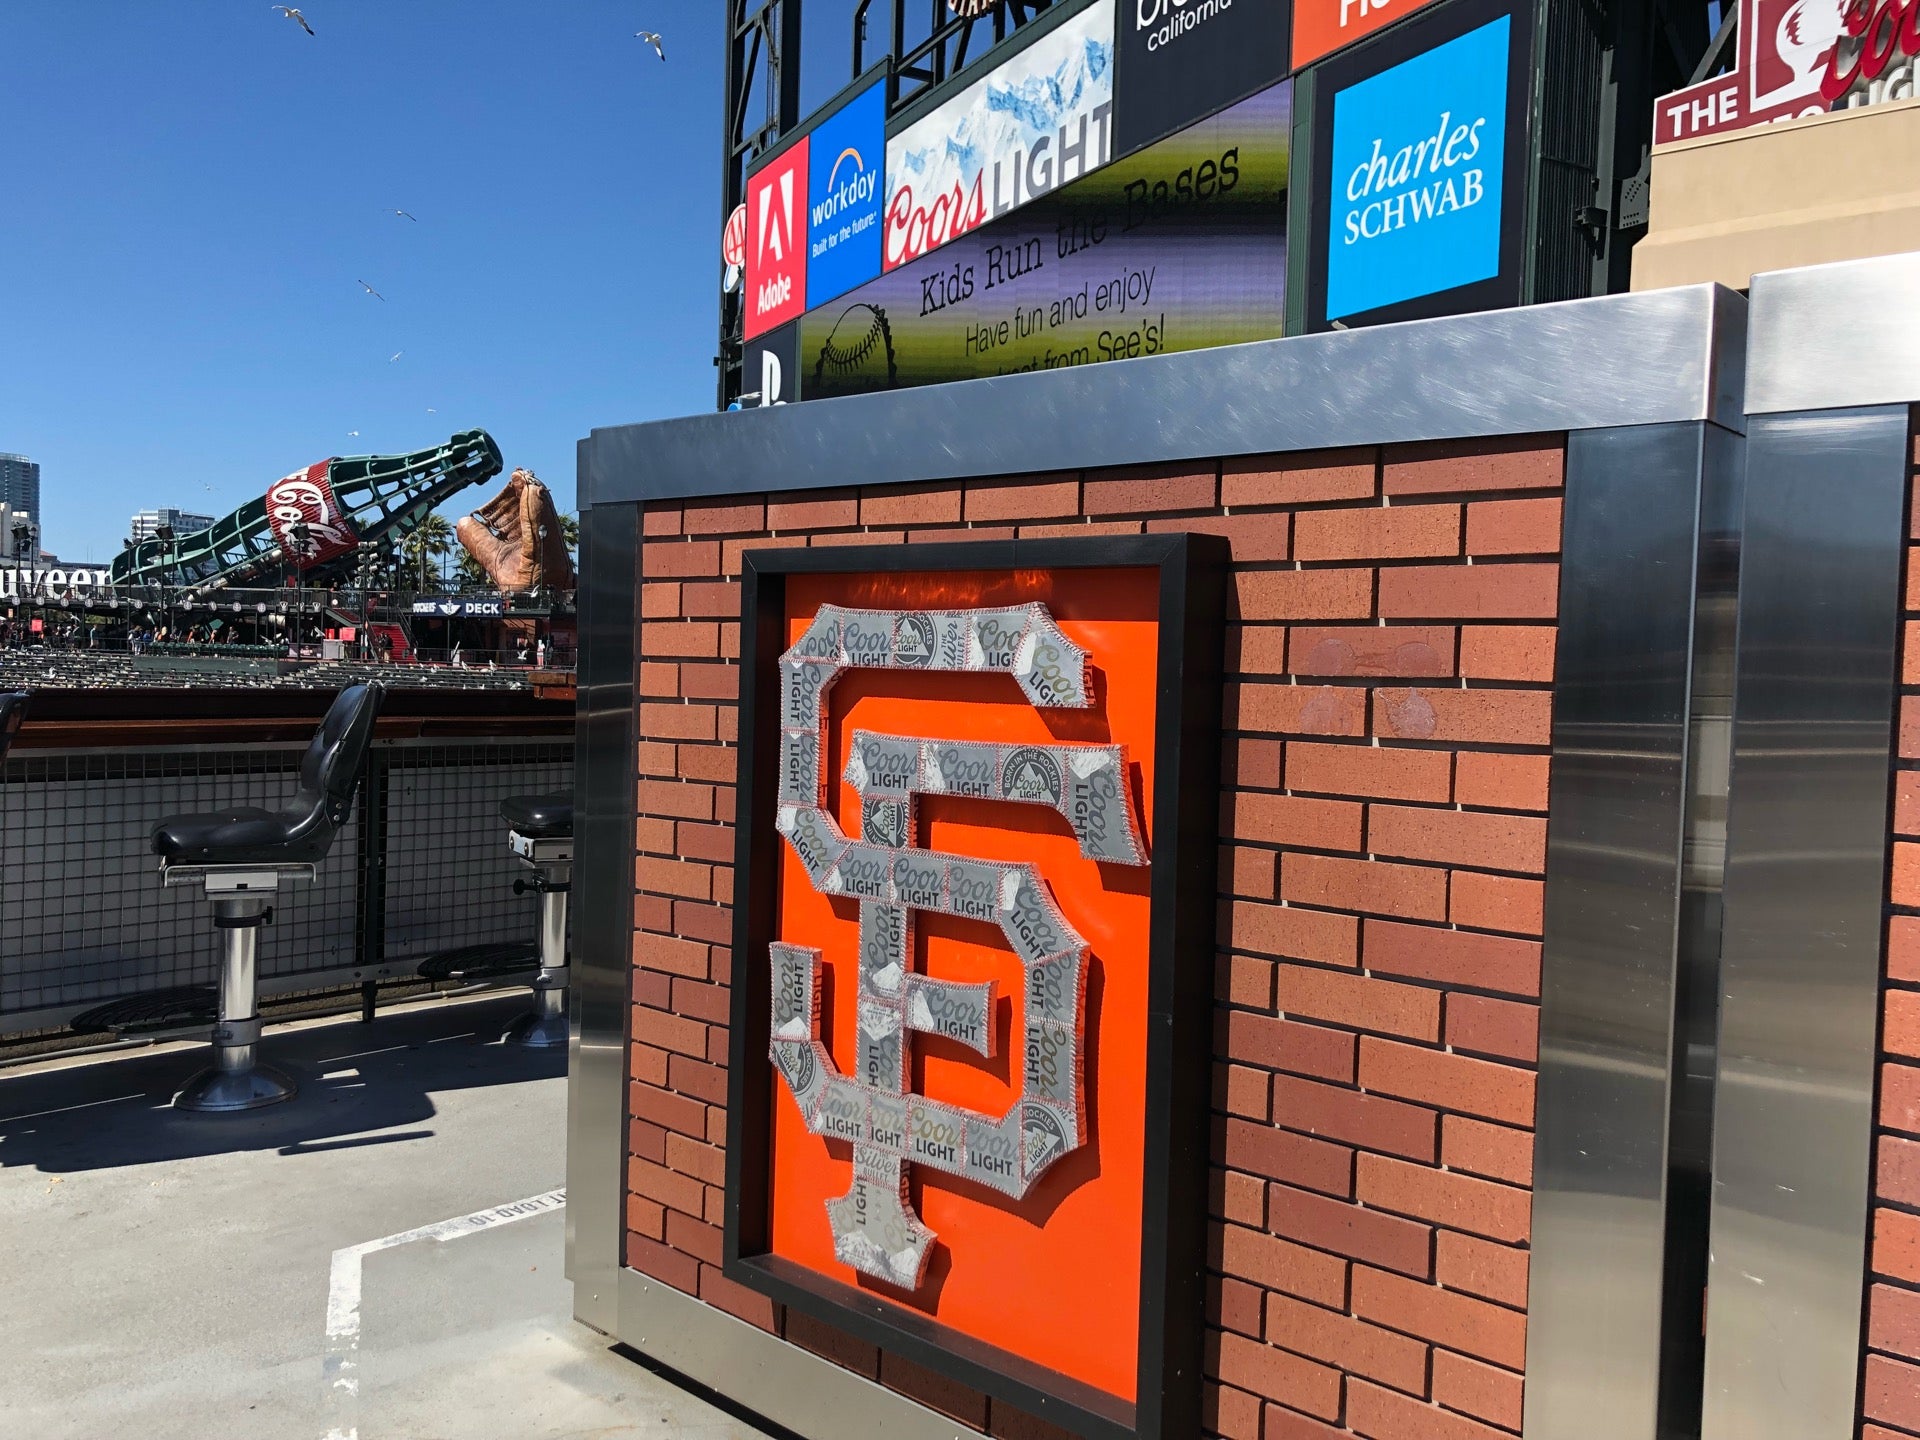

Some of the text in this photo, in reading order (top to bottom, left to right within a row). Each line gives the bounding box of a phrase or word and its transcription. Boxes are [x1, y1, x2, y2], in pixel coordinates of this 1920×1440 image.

[1148, 0, 1232, 51] california
[1667, 86, 1738, 138] THE
[1346, 111, 1486, 202] charles
[812, 169, 877, 228] workday
[884, 100, 1112, 272] Coors LIGHT
[1344, 168, 1484, 245] SCHWAB
[812, 237, 828, 258] Built
[828, 233, 839, 249] for
[839, 225, 851, 243] the
[919, 147, 1240, 318] Kids Run the Bases
[757, 272, 791, 316] Adobe
[966, 266, 1156, 357] Have fun and enjoy
[1044, 346, 1089, 370] from
[1097, 313, 1165, 363] See's!
[465, 602, 500, 614] DECK
[852, 652, 888, 667] LIGHT
[897, 644, 919, 653] LIGHT
[789, 672, 802, 722] LIGHT
[789, 743, 801, 793] LIGHT
[871, 772, 909, 789] LIGHT
[1014, 774, 1048, 793] Coors
[1022, 751, 1038, 761] THE
[1038, 754, 1059, 792] ROCKIES
[949, 780, 990, 799] LIGHT
[1019, 790, 1042, 800] LIGHT
[1074, 784, 1089, 842] LIGHT
[791, 828, 820, 873] LIGHT
[845, 877, 881, 897] LIGHT
[901, 888, 939, 908] LIGHT
[953, 897, 995, 920] LIGHT
[889, 906, 900, 958] LIGHT
[1010, 909, 1046, 961] LIGHT
[793, 962, 804, 1013] LIGHT
[937, 1017, 977, 1042] LIGHT
[779, 1050, 794, 1073] LIGHT
[1028, 1027, 1040, 1086] LIGHT
[825, 1115, 862, 1138] LIGHT
[856, 1147, 898, 1176] Silver
[916, 1138, 955, 1163] LIGHT
[971, 1150, 1013, 1177] LIGHT
[1029, 1142, 1048, 1164] LIGHT
